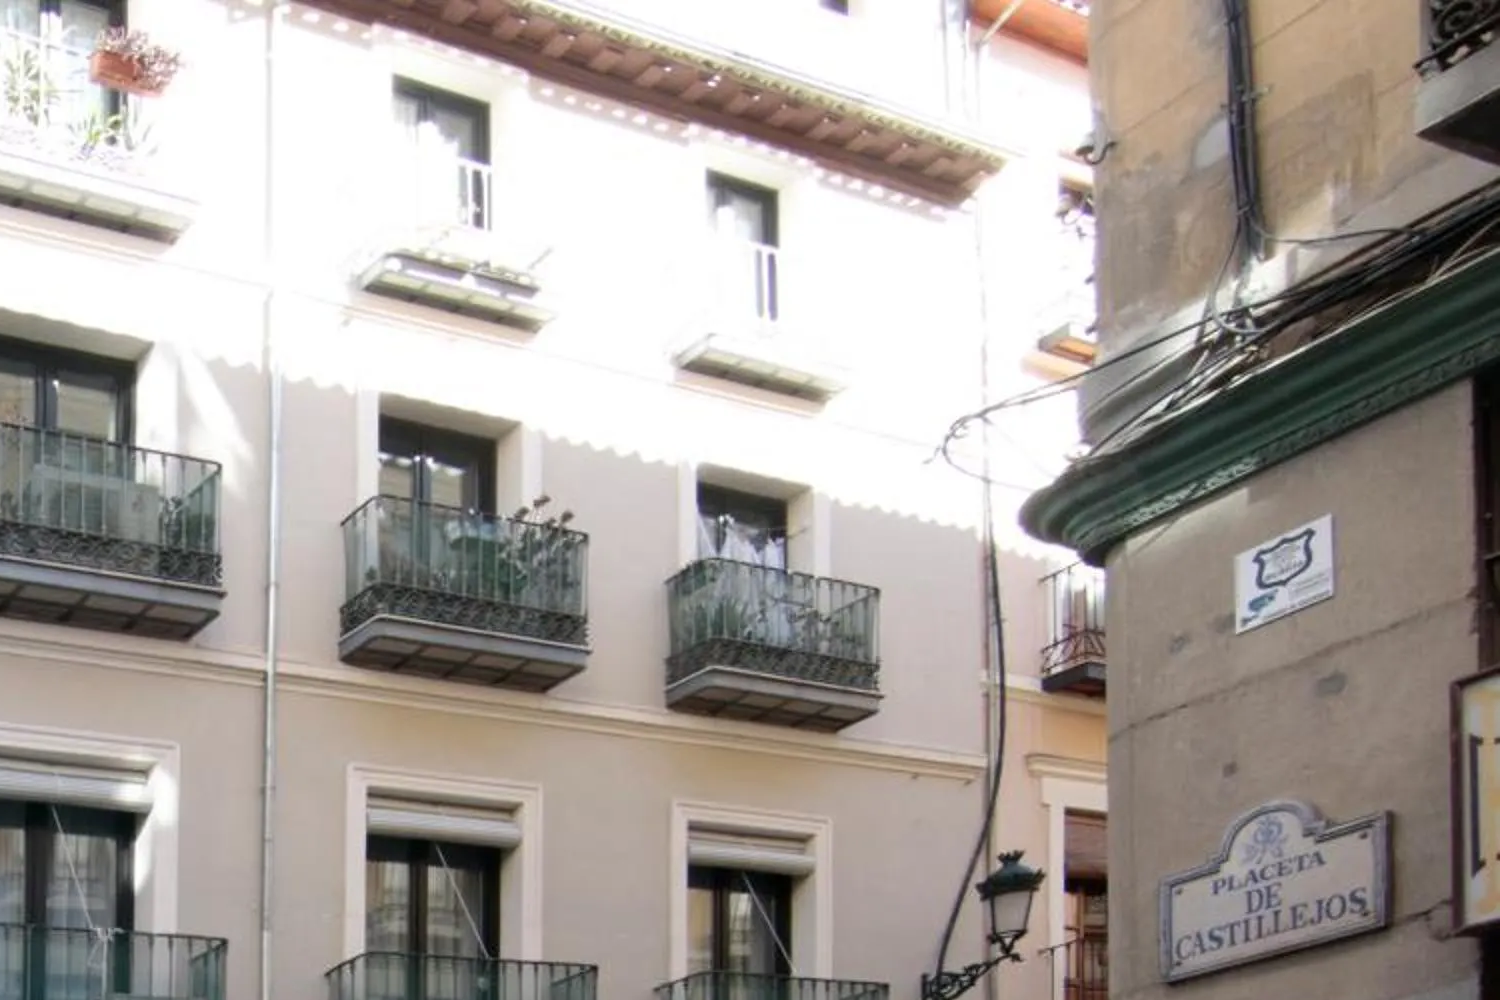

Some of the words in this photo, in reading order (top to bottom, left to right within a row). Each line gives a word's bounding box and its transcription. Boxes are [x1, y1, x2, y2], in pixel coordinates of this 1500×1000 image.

[1210, 850, 1327, 896] PLACETA
[1245, 882, 1283, 915] DE
[1175, 886, 1369, 961] CASTILLEJOS
